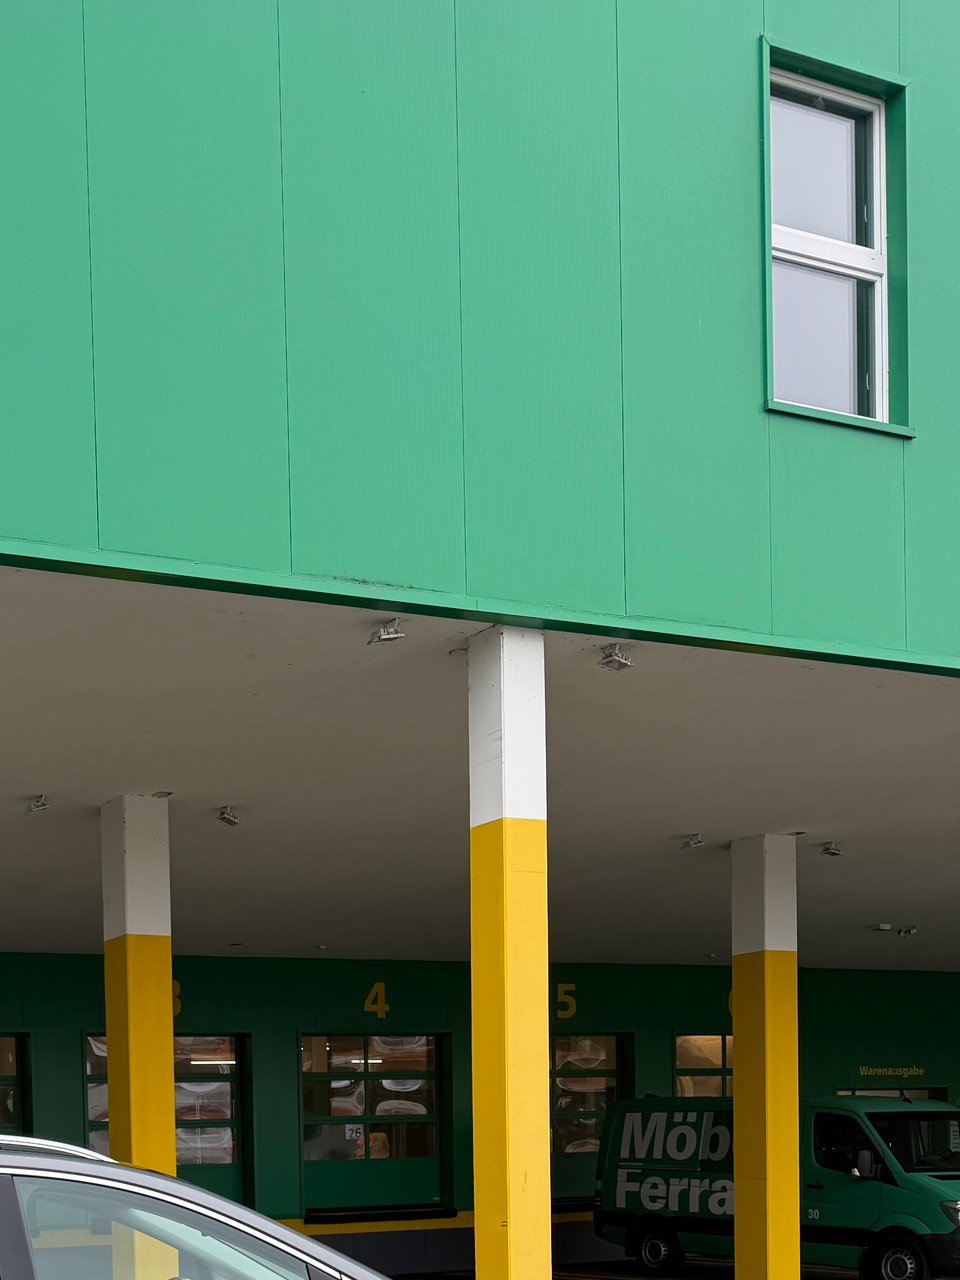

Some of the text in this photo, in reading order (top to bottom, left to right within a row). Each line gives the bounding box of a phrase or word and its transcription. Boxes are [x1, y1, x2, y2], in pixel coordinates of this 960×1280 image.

[364, 982, 389, 1018] 4
[557, 983, 577, 1018] 5
[859, 1065, 925, 1078] Warenausgabe
[348, 1127, 362, 1139] 26
[808, 1209, 819, 1219] 30
